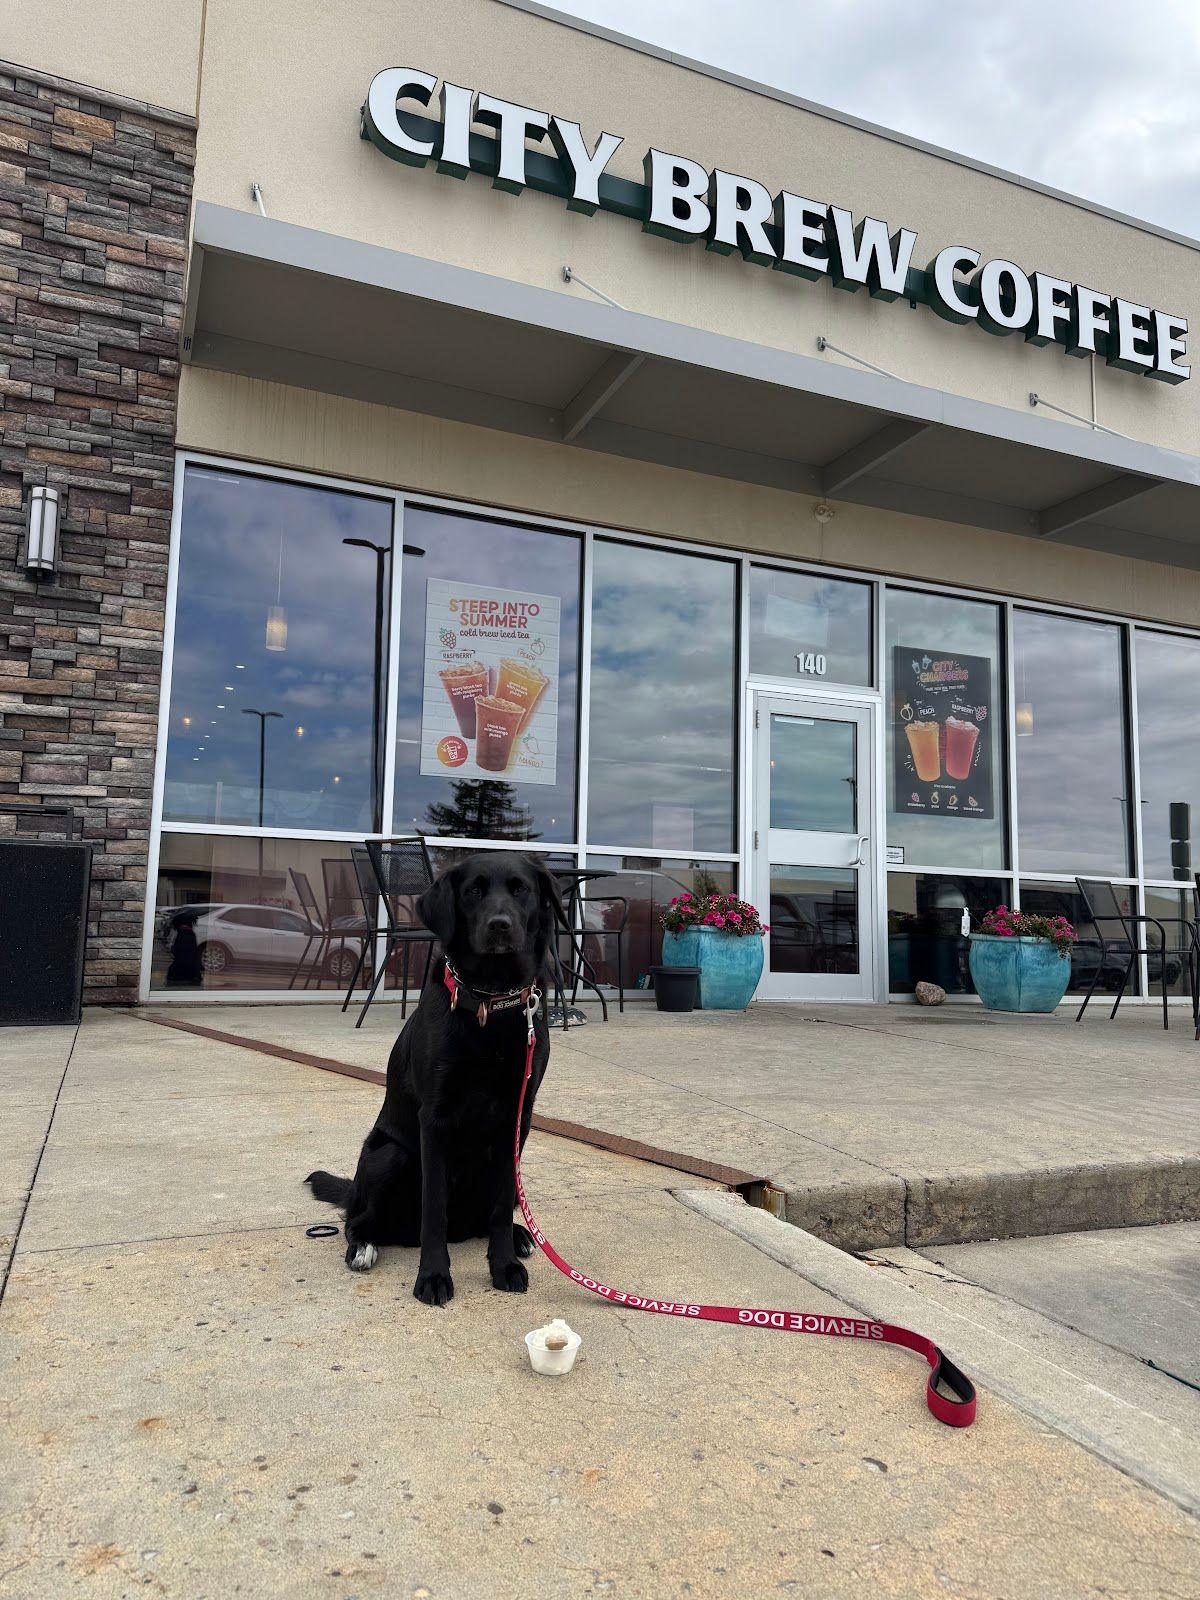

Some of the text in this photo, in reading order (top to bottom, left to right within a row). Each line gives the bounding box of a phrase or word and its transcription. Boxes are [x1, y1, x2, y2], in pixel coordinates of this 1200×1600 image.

[367, 66, 1192, 381] CITY BREW COFFEE
[449, 598, 540, 617] STEEP INTO
[460, 612, 528, 629] SUMMER
[459, 628, 530, 639] cold brew iced tea
[796, 652, 827, 675] 140
[932, 660, 954, 672] CITY
[569, 1269, 701, 1316] SERVICE DOG
[738, 1309, 885, 1340] SERVICE DOG
